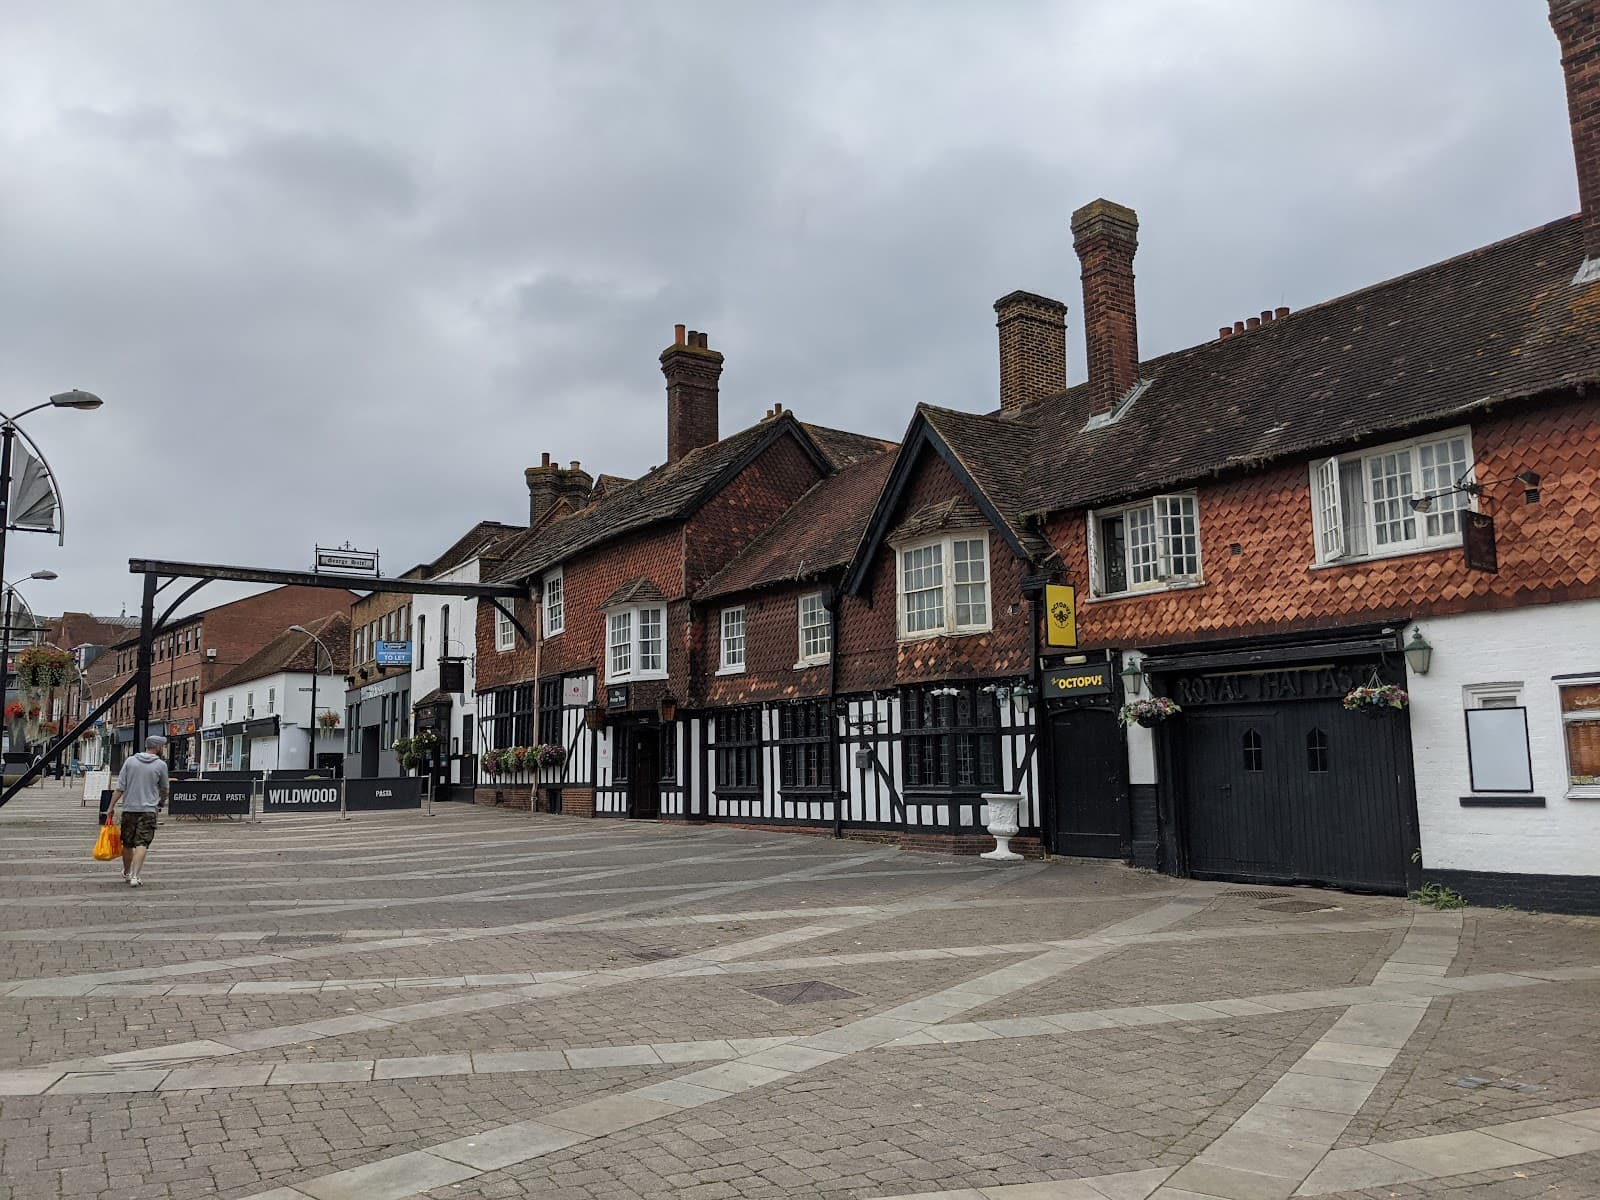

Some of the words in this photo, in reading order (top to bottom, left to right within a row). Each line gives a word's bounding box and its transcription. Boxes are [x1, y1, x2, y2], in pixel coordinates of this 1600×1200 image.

[1058, 674, 1103, 689] OCTOPUS
[173, 792, 198, 801] GRILLS
[201, 793, 221, 801] PIZZA
[269, 788, 338, 804] WILDWOOD
[375, 789, 393, 797] PASTA
